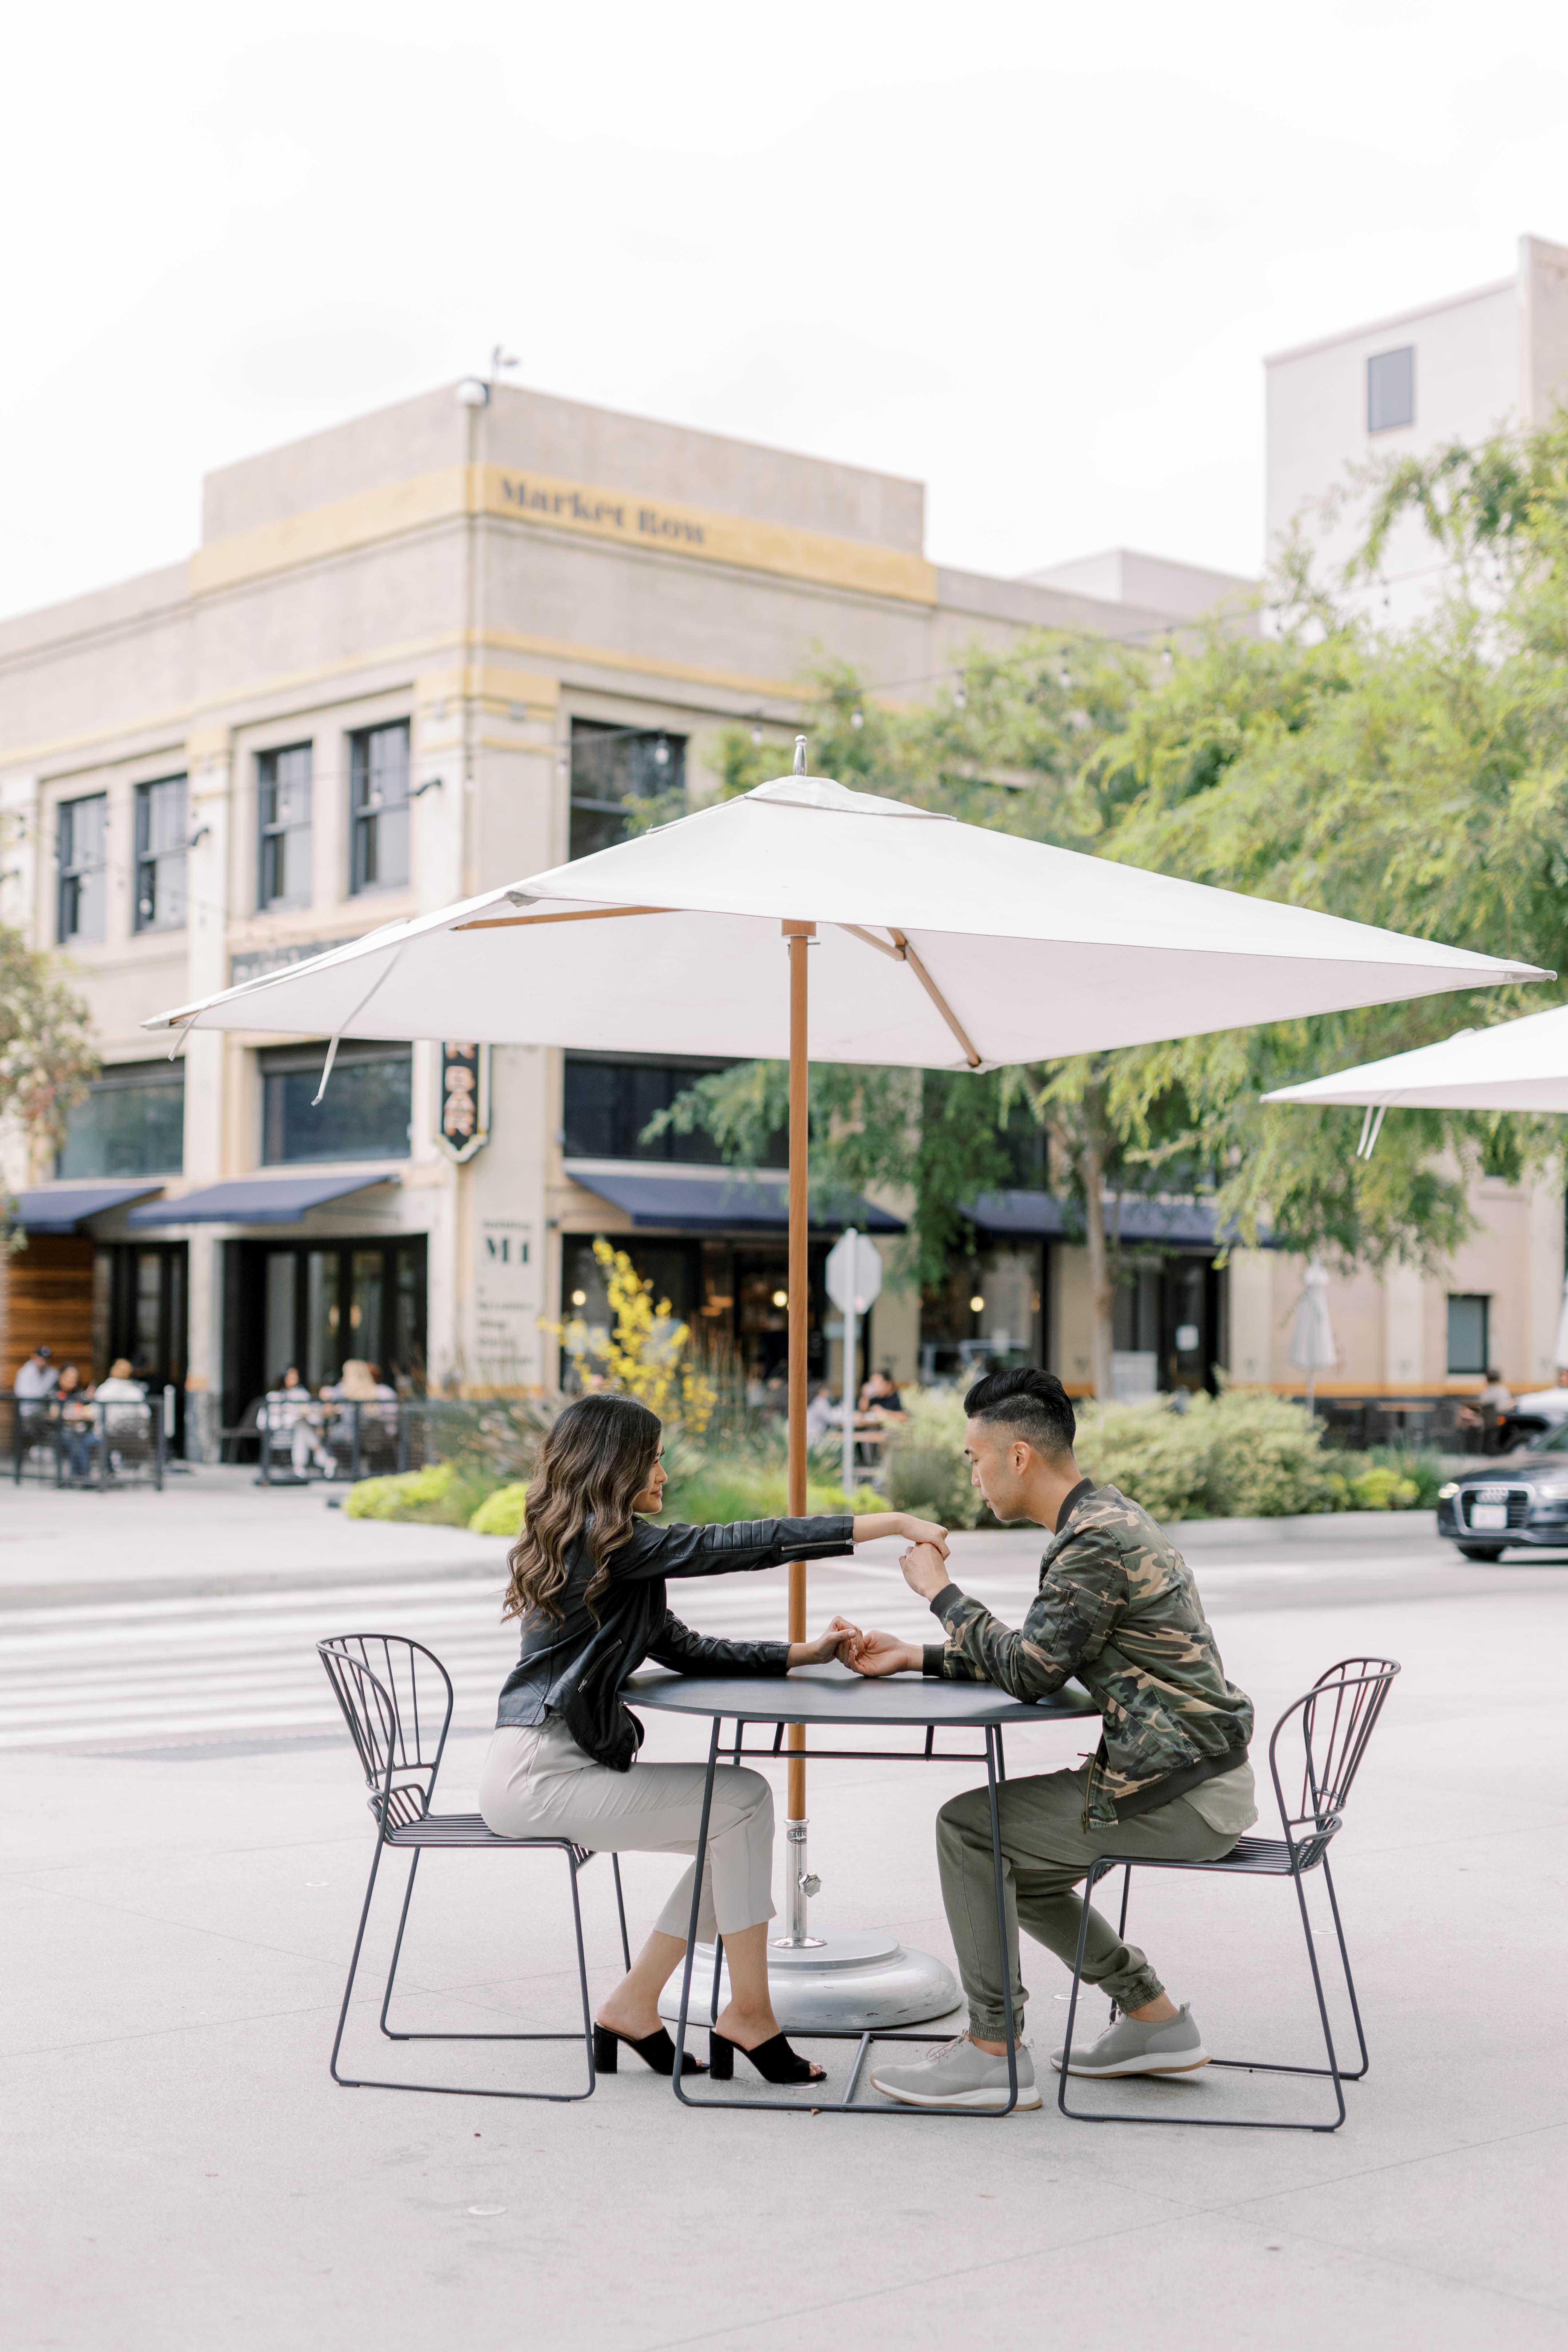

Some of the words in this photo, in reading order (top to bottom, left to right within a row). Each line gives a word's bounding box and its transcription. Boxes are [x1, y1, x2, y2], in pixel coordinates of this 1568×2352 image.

[501, 476, 624, 527] Market
[639, 507, 705, 545] Row
[444, 1065, 475, 1137] BAR
